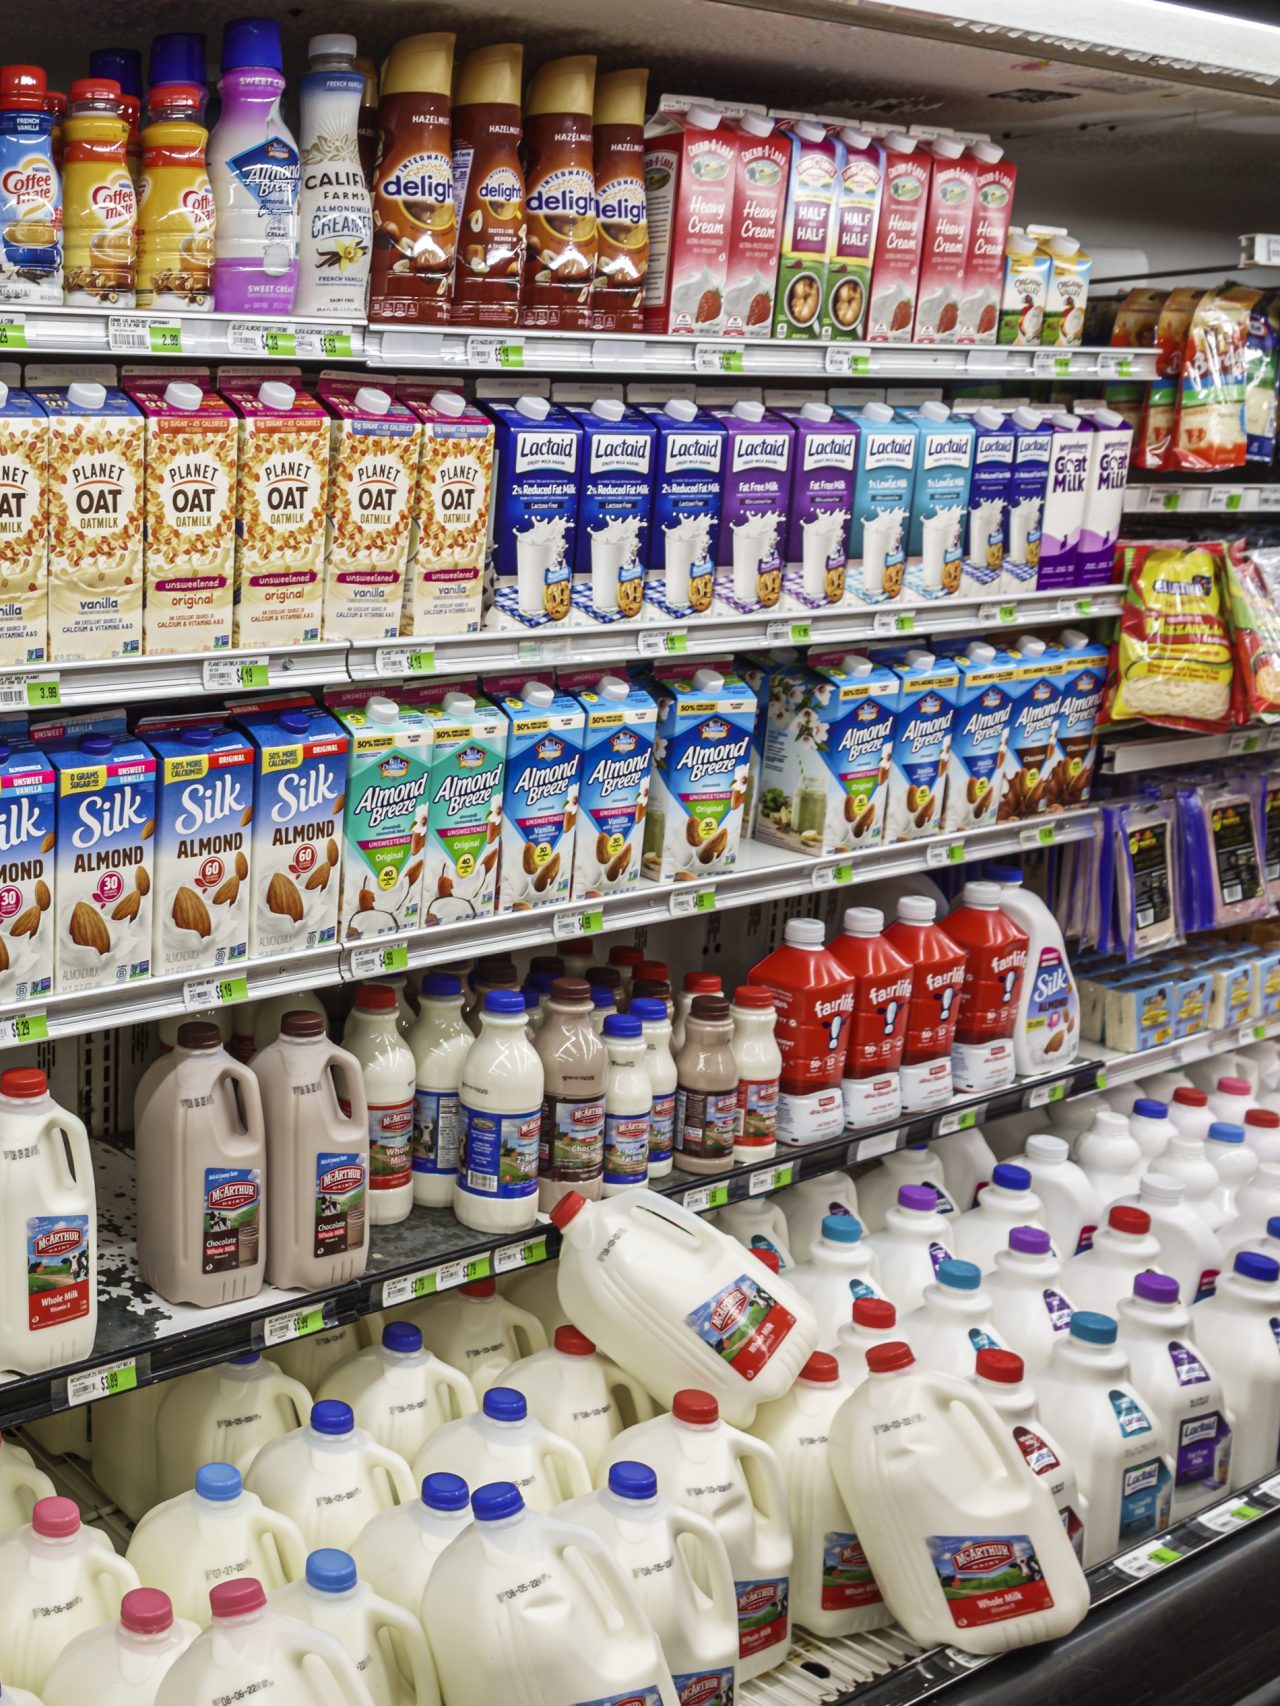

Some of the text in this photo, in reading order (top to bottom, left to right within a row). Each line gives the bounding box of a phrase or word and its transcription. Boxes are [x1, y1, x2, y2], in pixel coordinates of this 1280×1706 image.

[689, 200, 725, 218] Heavy
[799, 207, 826, 221] HALF
[687, 217, 724, 234] Cream
[797, 227, 825, 241] HALF
[162, 334, 179, 347] 2.99
[521, 437, 573, 458] Lactaid
[595, 438, 646, 459] Lactaid
[737, 438, 785, 457] Lactaid
[870, 438, 913, 457] Lactaid
[1055, 453, 1088, 474] Goat
[523, 484, 551, 494] Reduced
[552, 484, 563, 494] Fat
[564, 484, 576, 494] Milk
[1052, 473, 1085, 493] Milk
[165, 577, 220, 589] unsweetened
[172, 593, 213, 610] original
[40, 687, 57, 698] 3.99
[677, 738, 749, 770] Almond
[118, 765, 145, 776] UNSWEET
[691, 758, 736, 782] Breeze
[354, 774, 428, 817] Almond
[71, 787, 148, 849] Silk
[369, 798, 416, 826] Breeze
[369, 836, 411, 847] UNSWEETENED
[74, 846, 144, 874] ALMOND
[299, 849, 312, 862] 60
[376, 850, 404, 862] Original
[869, 979, 912, 1005] fairlife
[1034, 970, 1068, 1001] Silk
[212, 1185, 255, 1200] McARTHUR
[38, 1230, 80, 1251] McARTHUR
[207, 1235, 237, 1246] Chocolate
[41, 1290, 78, 1306] Whole Milk
[1125, 1468, 1158, 1492] Lactaid
[955, 1543, 1010, 1570] McARTHUR
